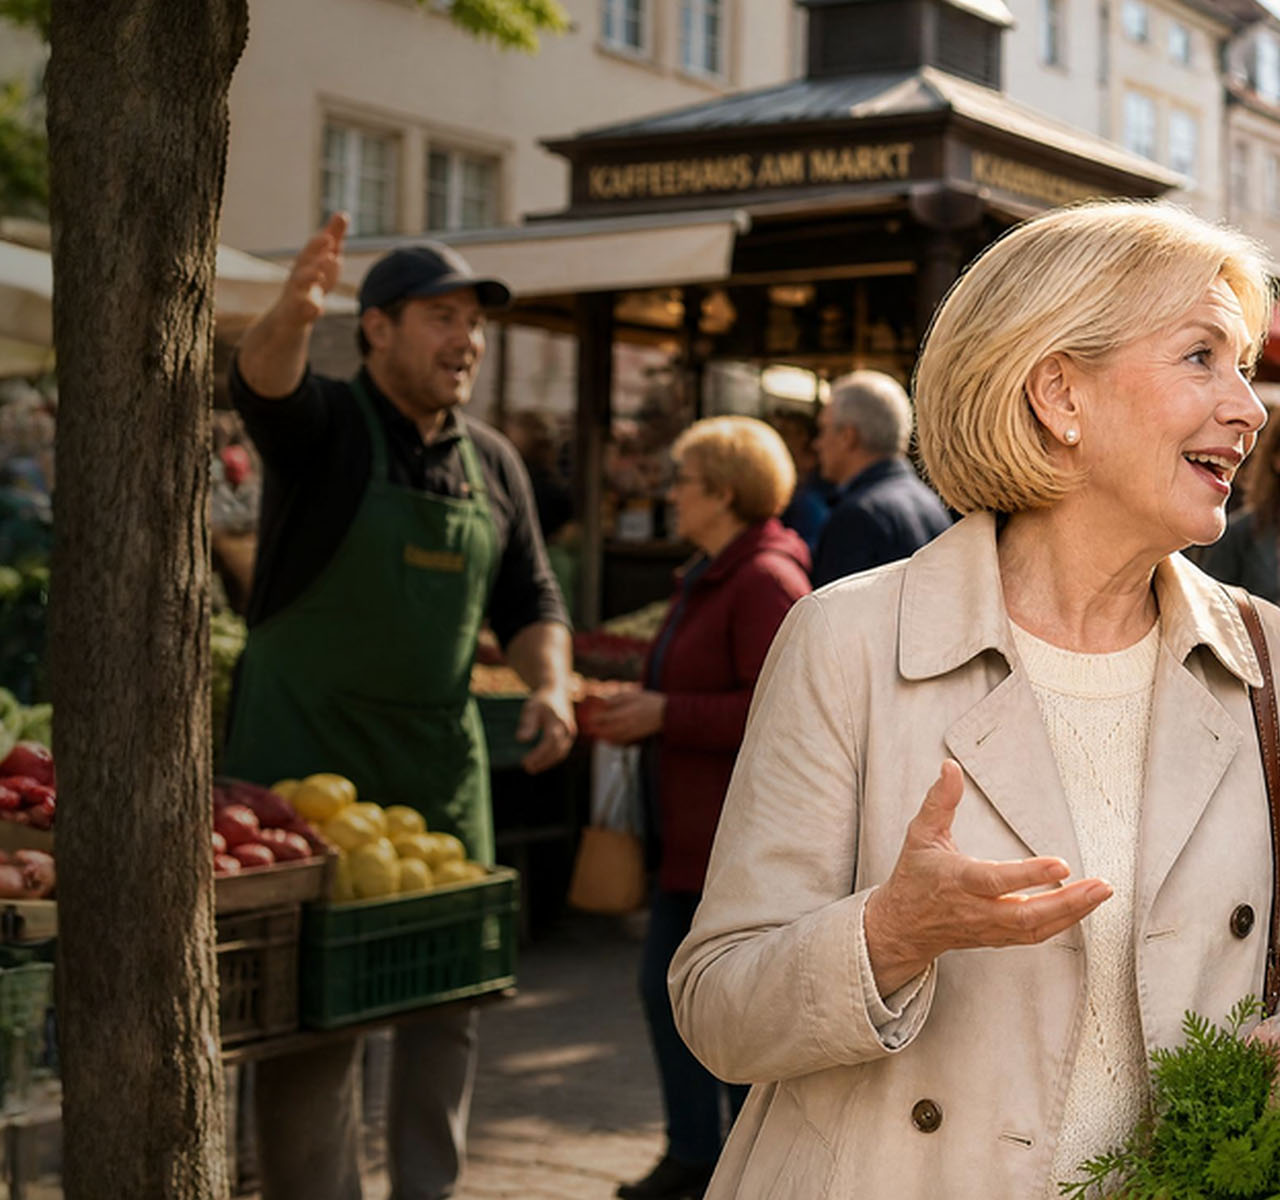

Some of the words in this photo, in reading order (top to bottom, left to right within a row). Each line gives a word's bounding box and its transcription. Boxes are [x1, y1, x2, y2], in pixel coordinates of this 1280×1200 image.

[588, 153, 753, 198] KAFFEEHAUS
[756, 152, 804, 185] AM
[810, 142, 912, 182] MARKT
